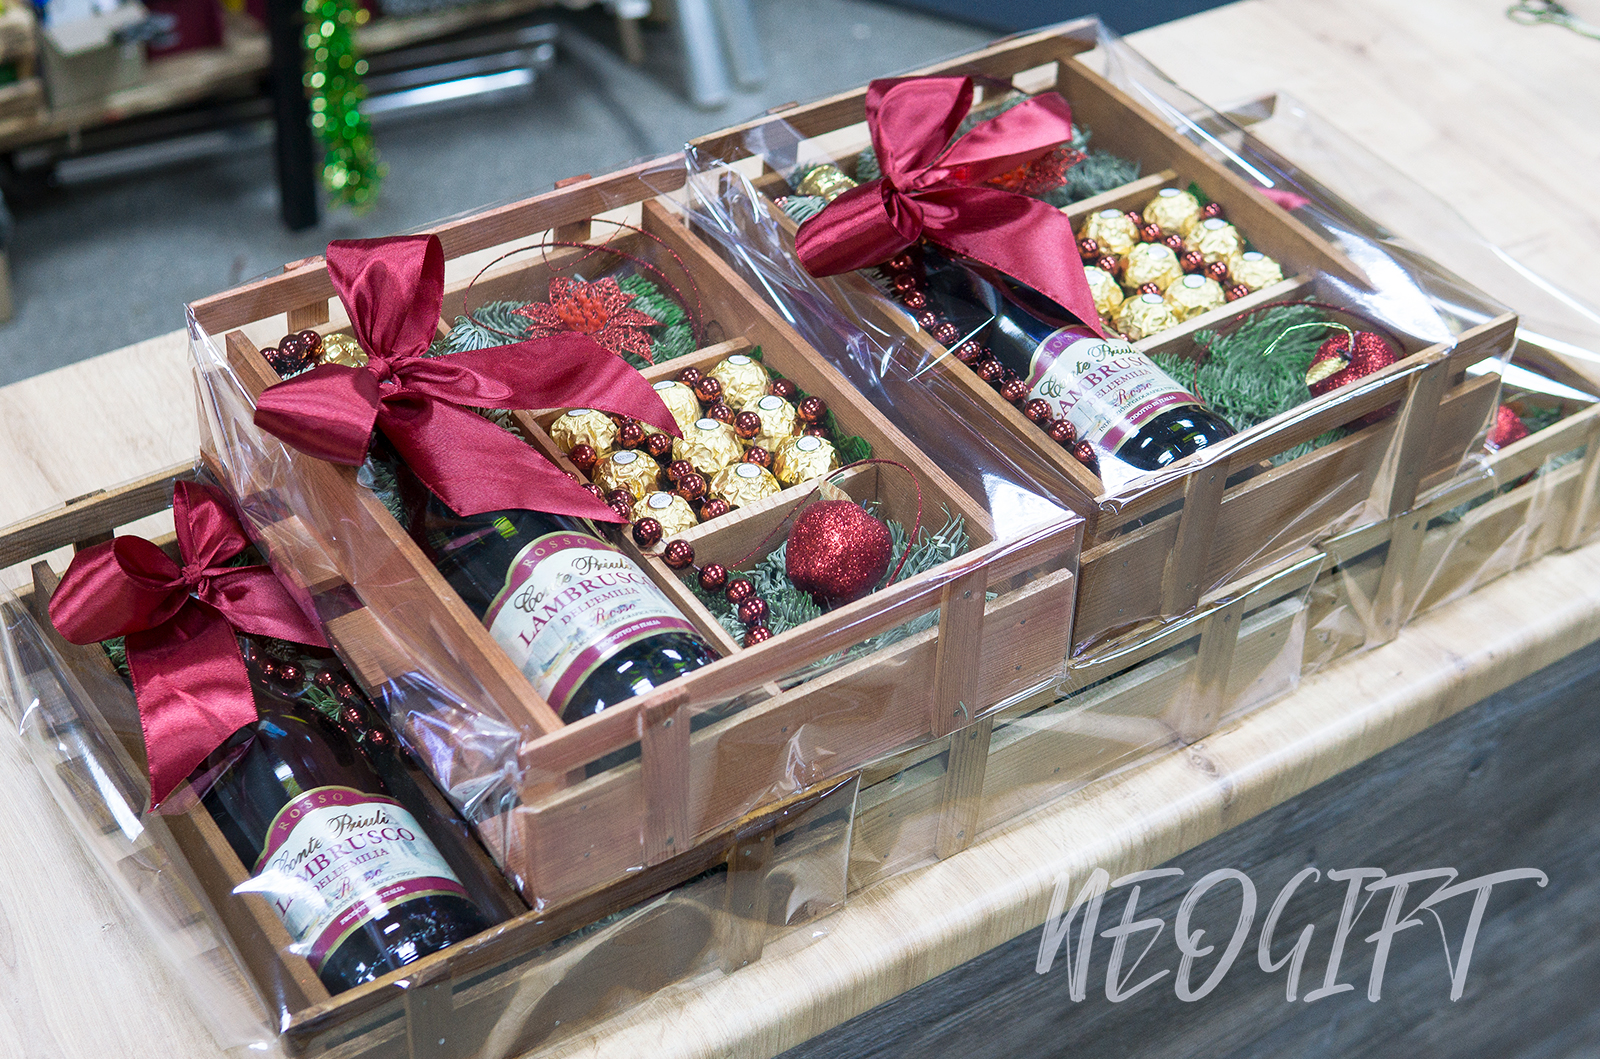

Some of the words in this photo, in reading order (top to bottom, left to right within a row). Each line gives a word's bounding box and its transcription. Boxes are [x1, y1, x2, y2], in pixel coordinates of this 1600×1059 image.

[1059, 355, 1150, 418] AMBRUSC
[1110, 382, 1152, 407] Rosso
[522, 533, 588, 568] ROSSO
[571, 555, 633, 575] Priuli
[517, 571, 657, 648] LAMBRUSCO
[560, 586, 640, 626] DELL'EMILIA
[588, 602, 637, 627] Rosso
[278, 792, 344, 831] ROSSO
[327, 809, 390, 838] Priuli
[275, 827, 415, 917] LMBRUSCO
